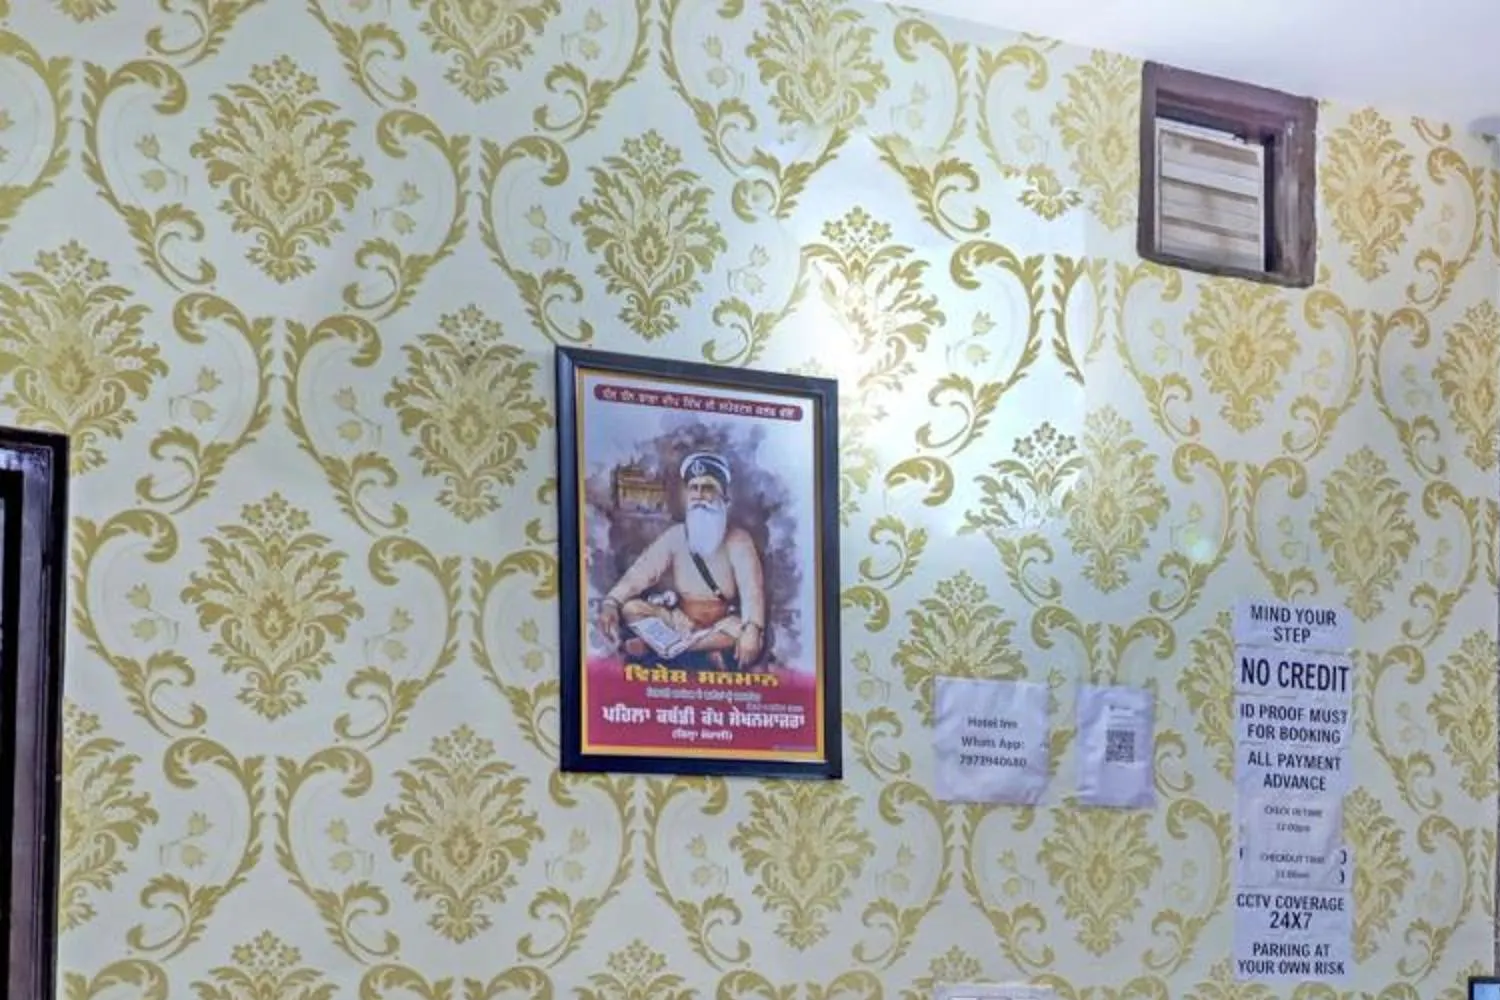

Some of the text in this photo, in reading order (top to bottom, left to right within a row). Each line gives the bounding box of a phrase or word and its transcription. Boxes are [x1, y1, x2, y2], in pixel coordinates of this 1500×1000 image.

[1250, 604, 1337, 626] MIND YOUR
[1273, 626, 1311, 643] STEP
[698, 671, 779, 687] ਸਨਮਾਨ
[1241, 657, 1350, 692] NO CREDIT
[602, 703, 651, 724] ਪਹਿਲਾ
[1240, 703, 1347, 724] ID PROOF MUST
[1248, 723, 1341, 744] FOR BOOKING
[1248, 751, 1341, 770] ALL PAYMENT
[1264, 773, 1326, 791] ADVANCE
[1236, 893, 1345, 911] CCTV COVERAGE
[1269, 911, 1313, 930] 24X7
[1253, 941, 1331, 958] PARKING AT
[1238, 959, 1345, 976] YOUR OWN RISK
